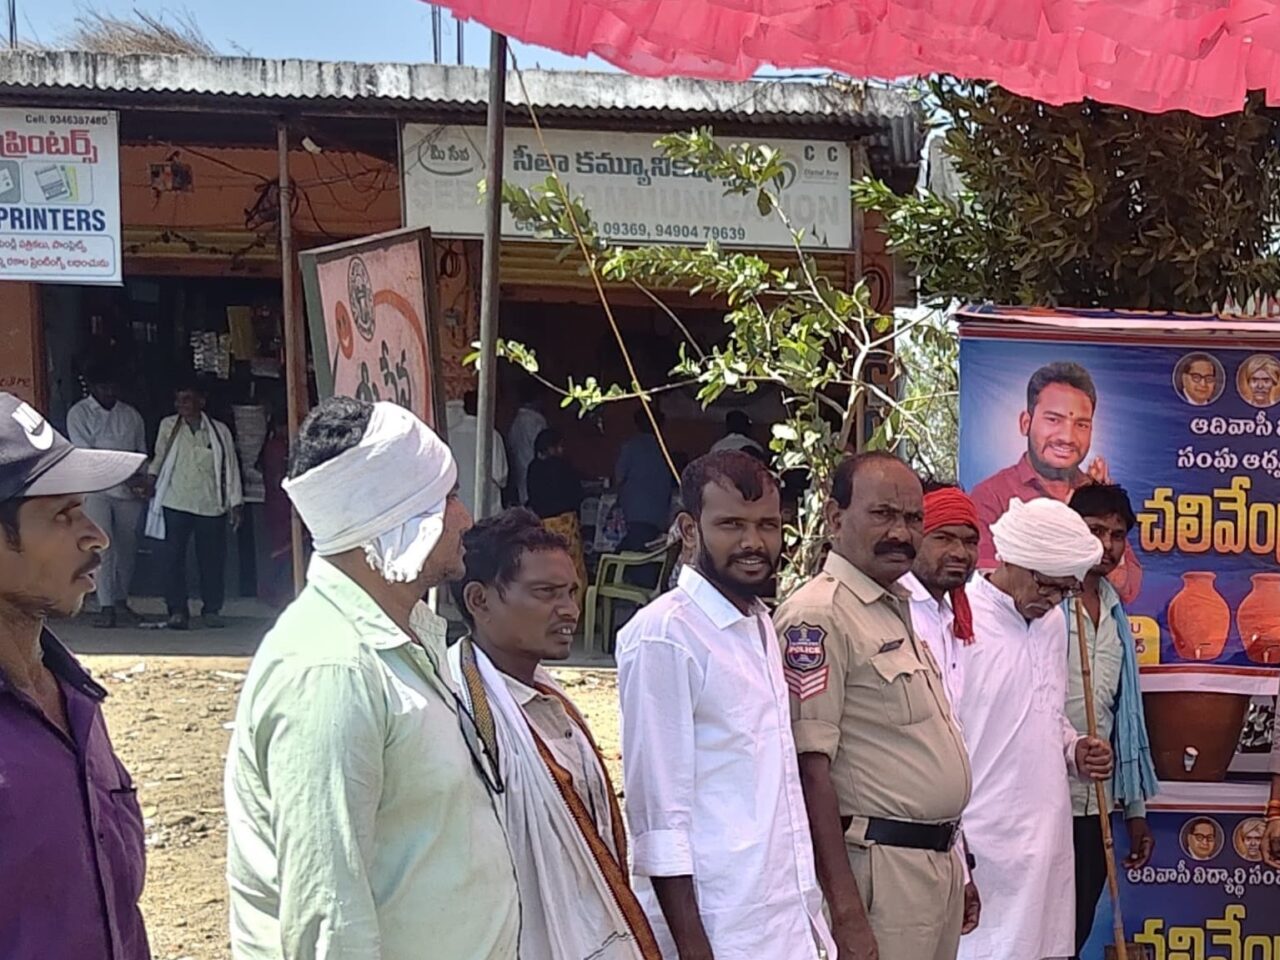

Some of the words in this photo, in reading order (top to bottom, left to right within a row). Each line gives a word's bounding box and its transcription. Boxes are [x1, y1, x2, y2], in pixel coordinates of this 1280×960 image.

[513, 145, 569, 173] సీతా
[0, 207, 106, 232] PRINTERS
[655, 223, 699, 238] 94904
[703, 225, 746, 240] 79639
[1190, 411, 1272, 437] ఆదివాసీ
[1177, 446, 1239, 474] సంఘ
[1127, 859, 1190, 885] ఆదివాసీ
